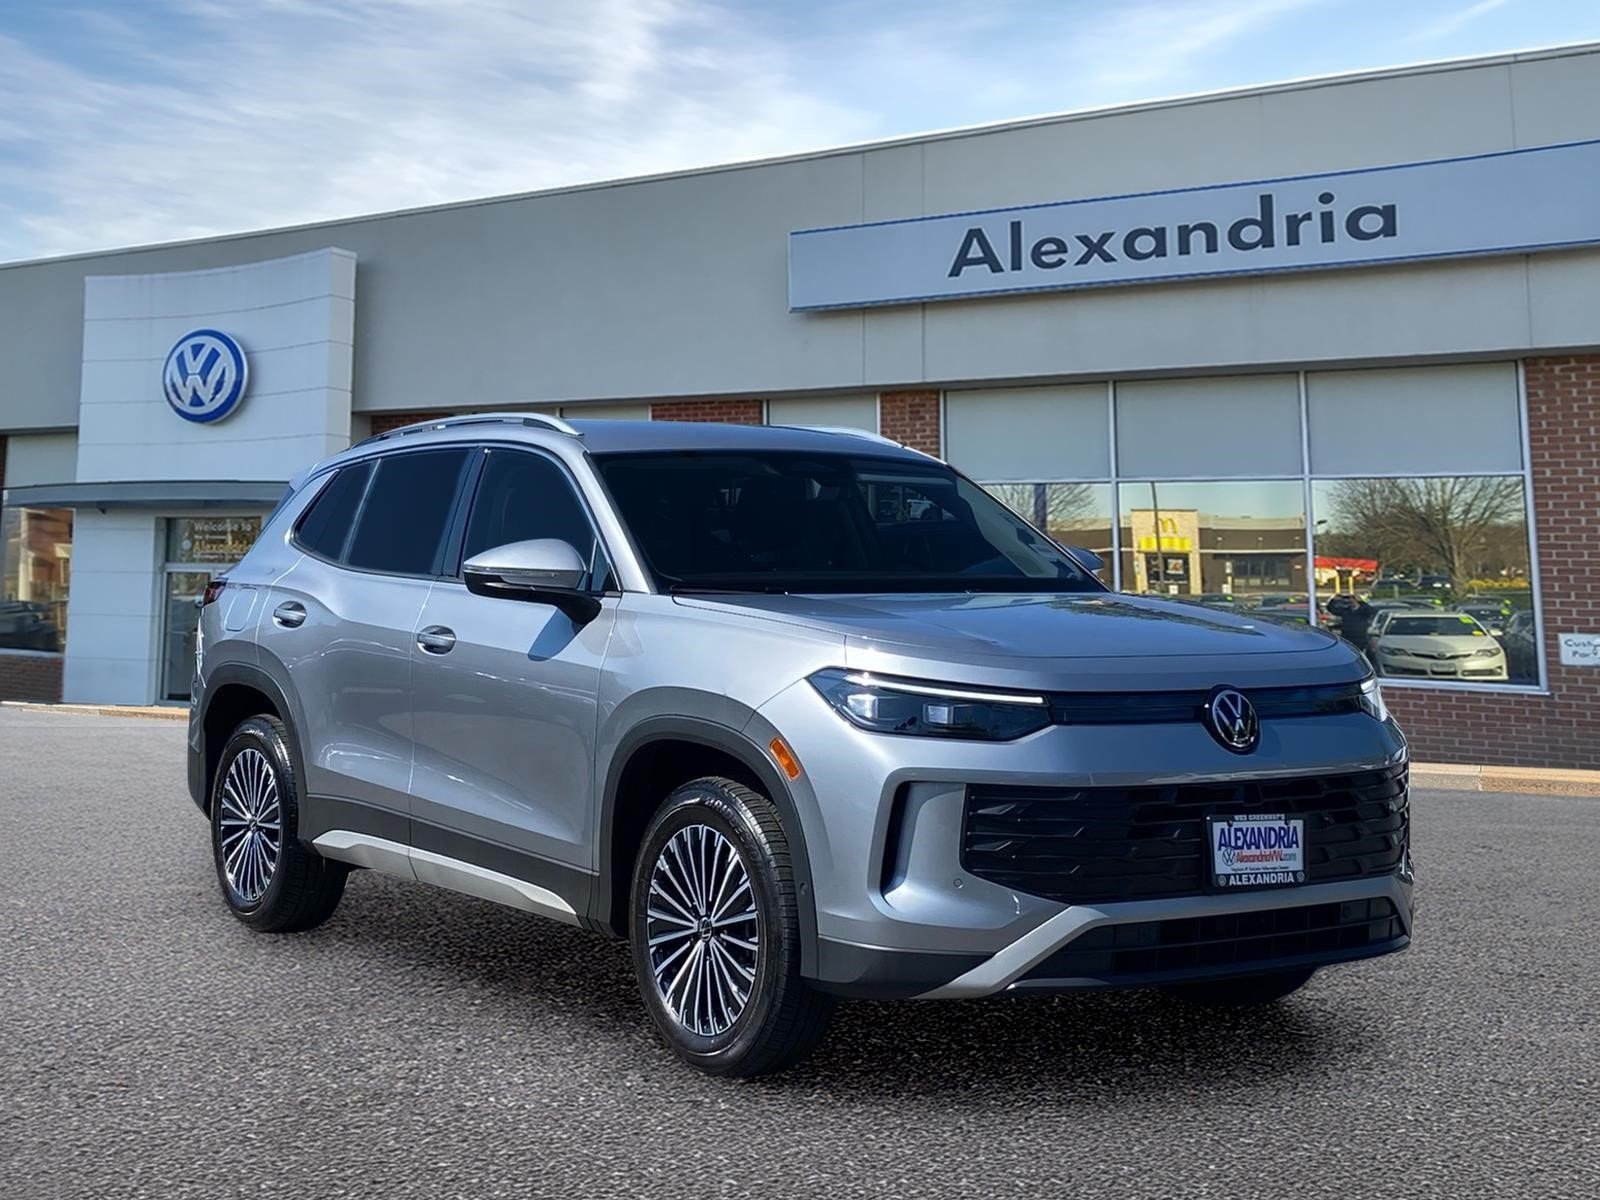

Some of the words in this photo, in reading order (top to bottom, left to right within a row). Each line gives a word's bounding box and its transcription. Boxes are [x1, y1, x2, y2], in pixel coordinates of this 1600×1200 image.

[947, 192, 1398, 278] Alexandria
[166, 335, 238, 415] VW
[1218, 826, 1299, 851] ALEXANDRIA
[1229, 873, 1295, 886] ALEXANDRIA
